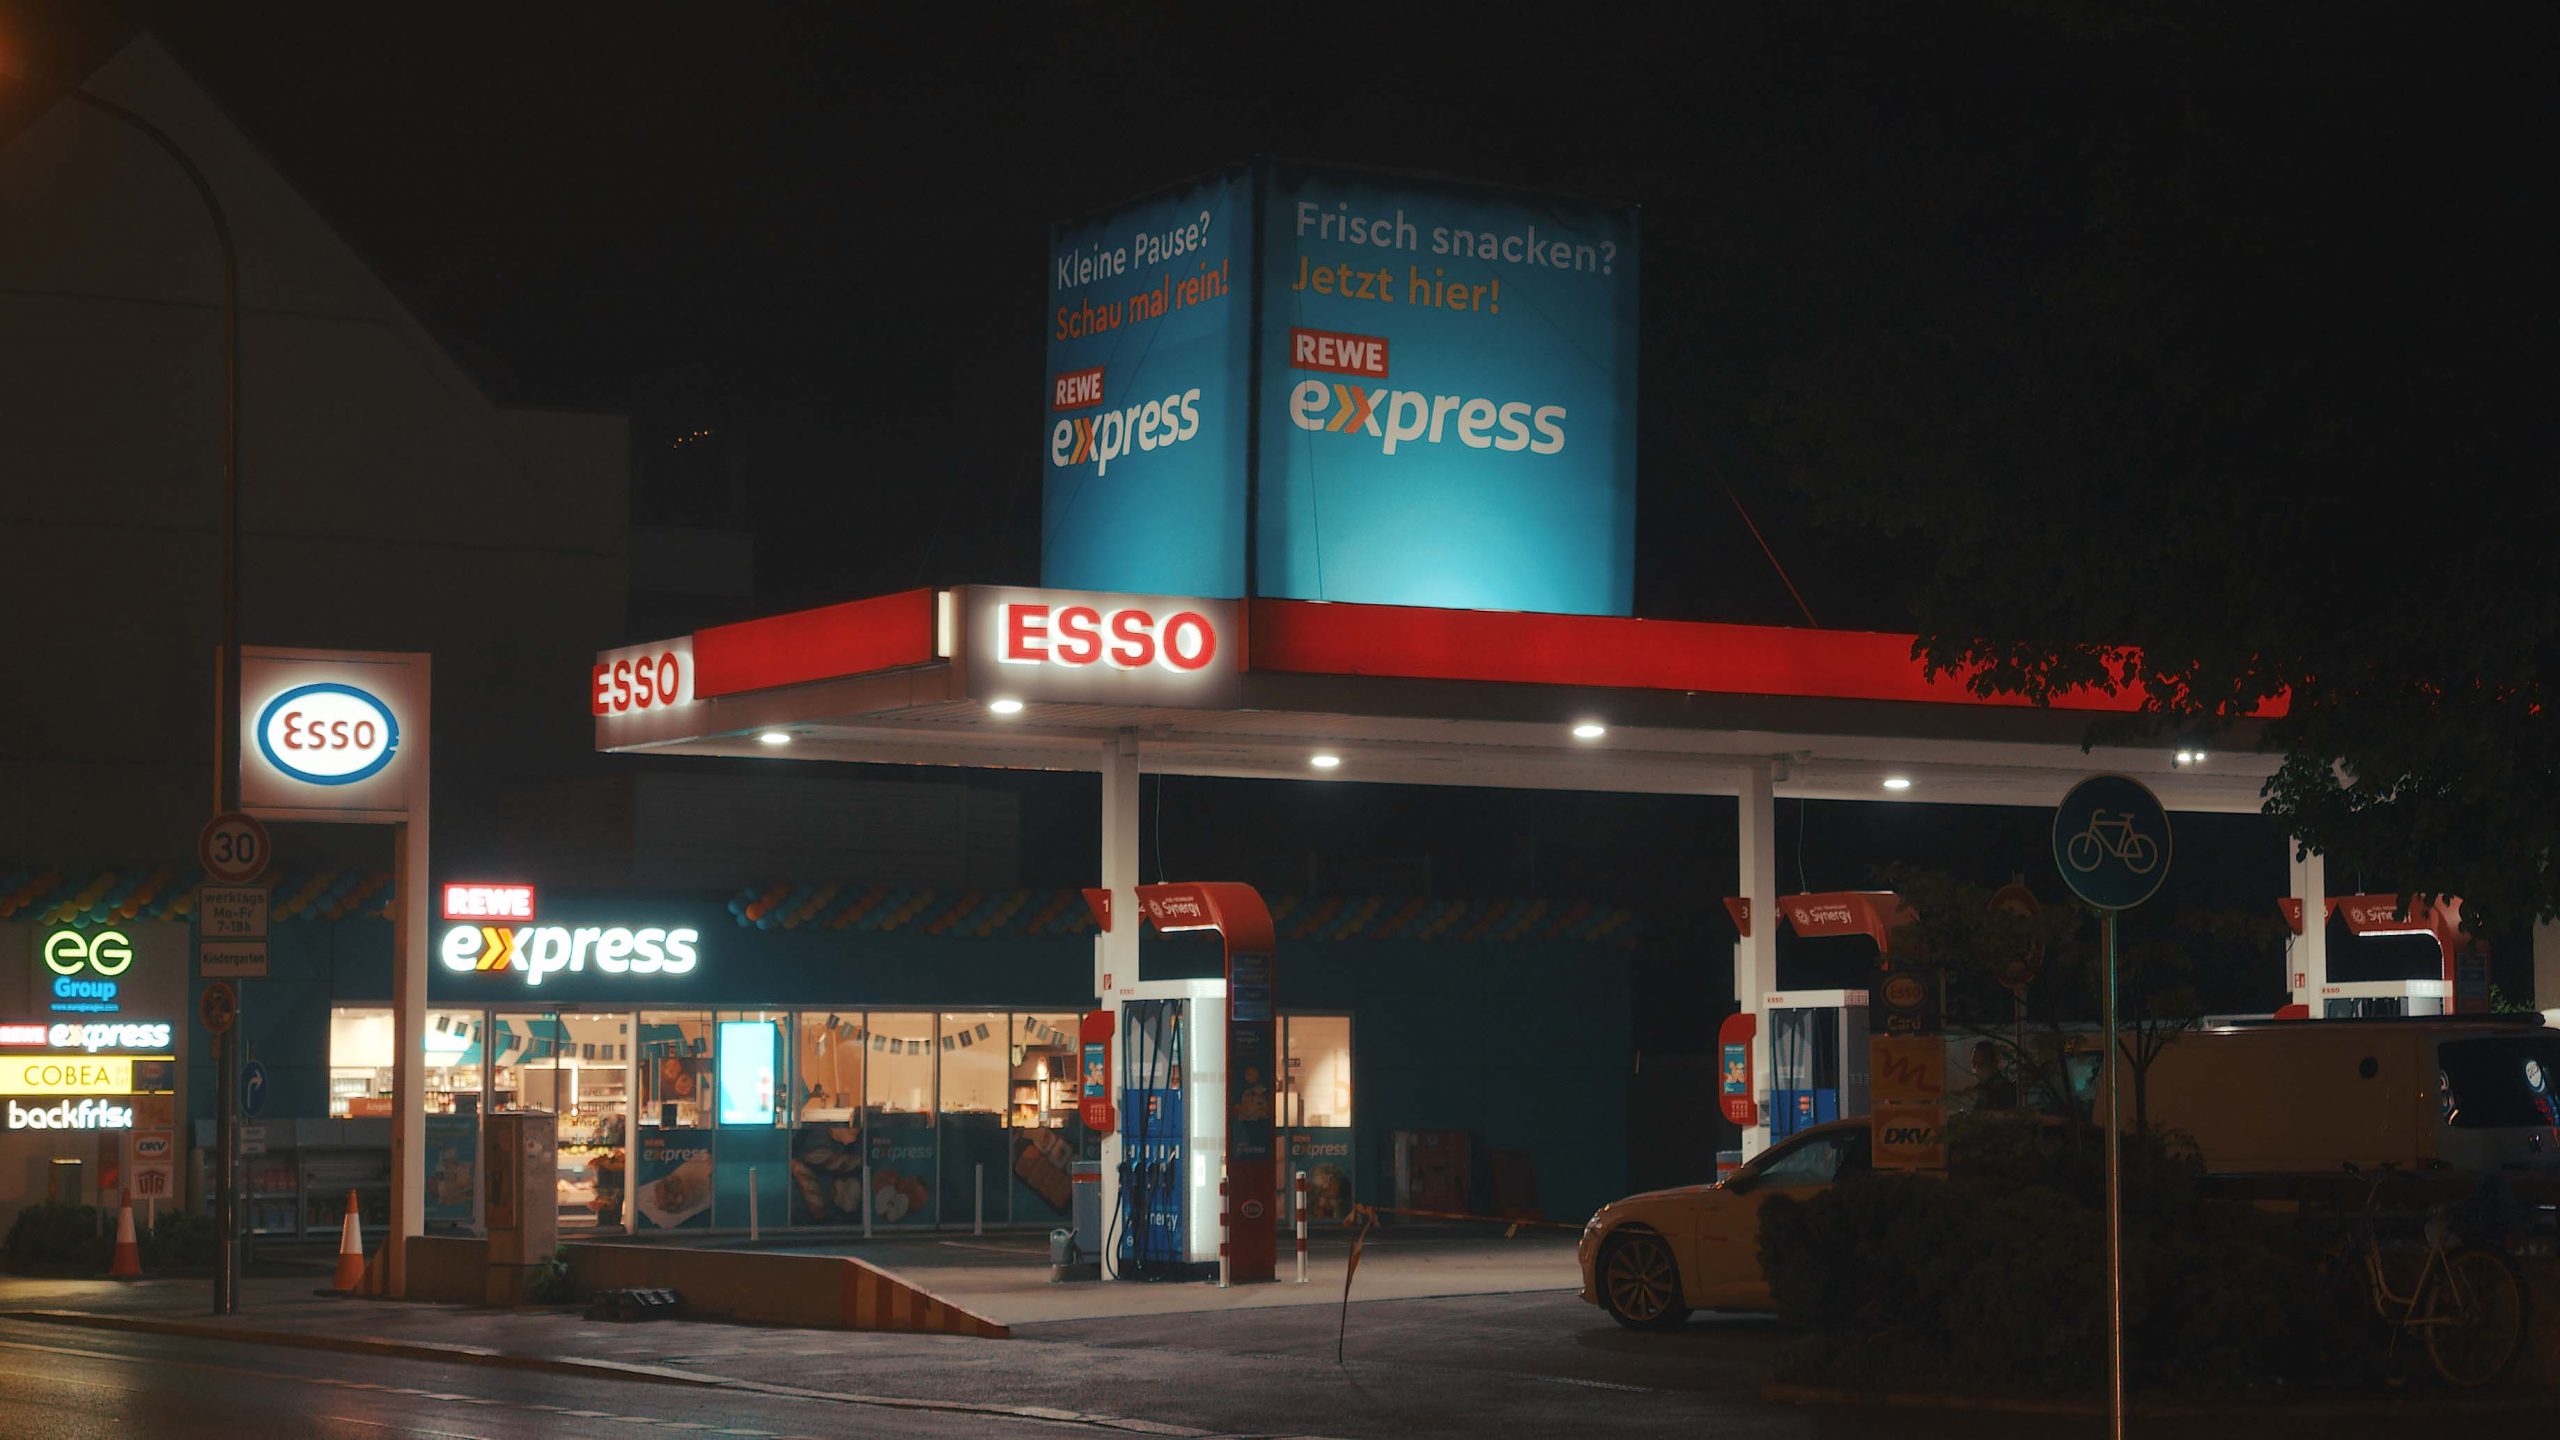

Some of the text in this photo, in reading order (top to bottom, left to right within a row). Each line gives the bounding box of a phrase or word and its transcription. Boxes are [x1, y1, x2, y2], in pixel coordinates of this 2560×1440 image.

[1058, 210, 1211, 290] Kleine Pause?
[1296, 201, 1617, 276] Frisch snacken?
[1292, 256, 1500, 314] Jetzt hier!
[1056, 258, 1229, 341] Schau mal rein!
[1296, 334, 1383, 372] REWE
[1056, 373, 1101, 405] REWE
[1289, 380, 1567, 456] express
[1052, 388, 1200, 477] express
[1004, 604, 1217, 670] ESSO
[593, 651, 679, 715] ESSO
[215, 833, 253, 863] 30
[205, 892, 264, 905] werktags
[447, 888, 530, 916] REWE
[1162, 901, 1201, 918] Synergy
[1741, 906, 1749, 919] 3
[1810, 909, 1852, 925] Synergy
[2294, 907, 2301, 919] 5
[203, 952, 264, 965] Kindergarten
[442, 925, 699, 985] express
[54, 977, 117, 1001] Group
[1888, 1016, 1921, 1030] Card
[49, 1023, 171, 1052] express
[24, 1065, 111, 1086] COBEA
[139, 1142, 165, 1151] DKV
[1884, 1128, 1931, 1144] DKV
[1292, 1143, 1348, 1158] express
